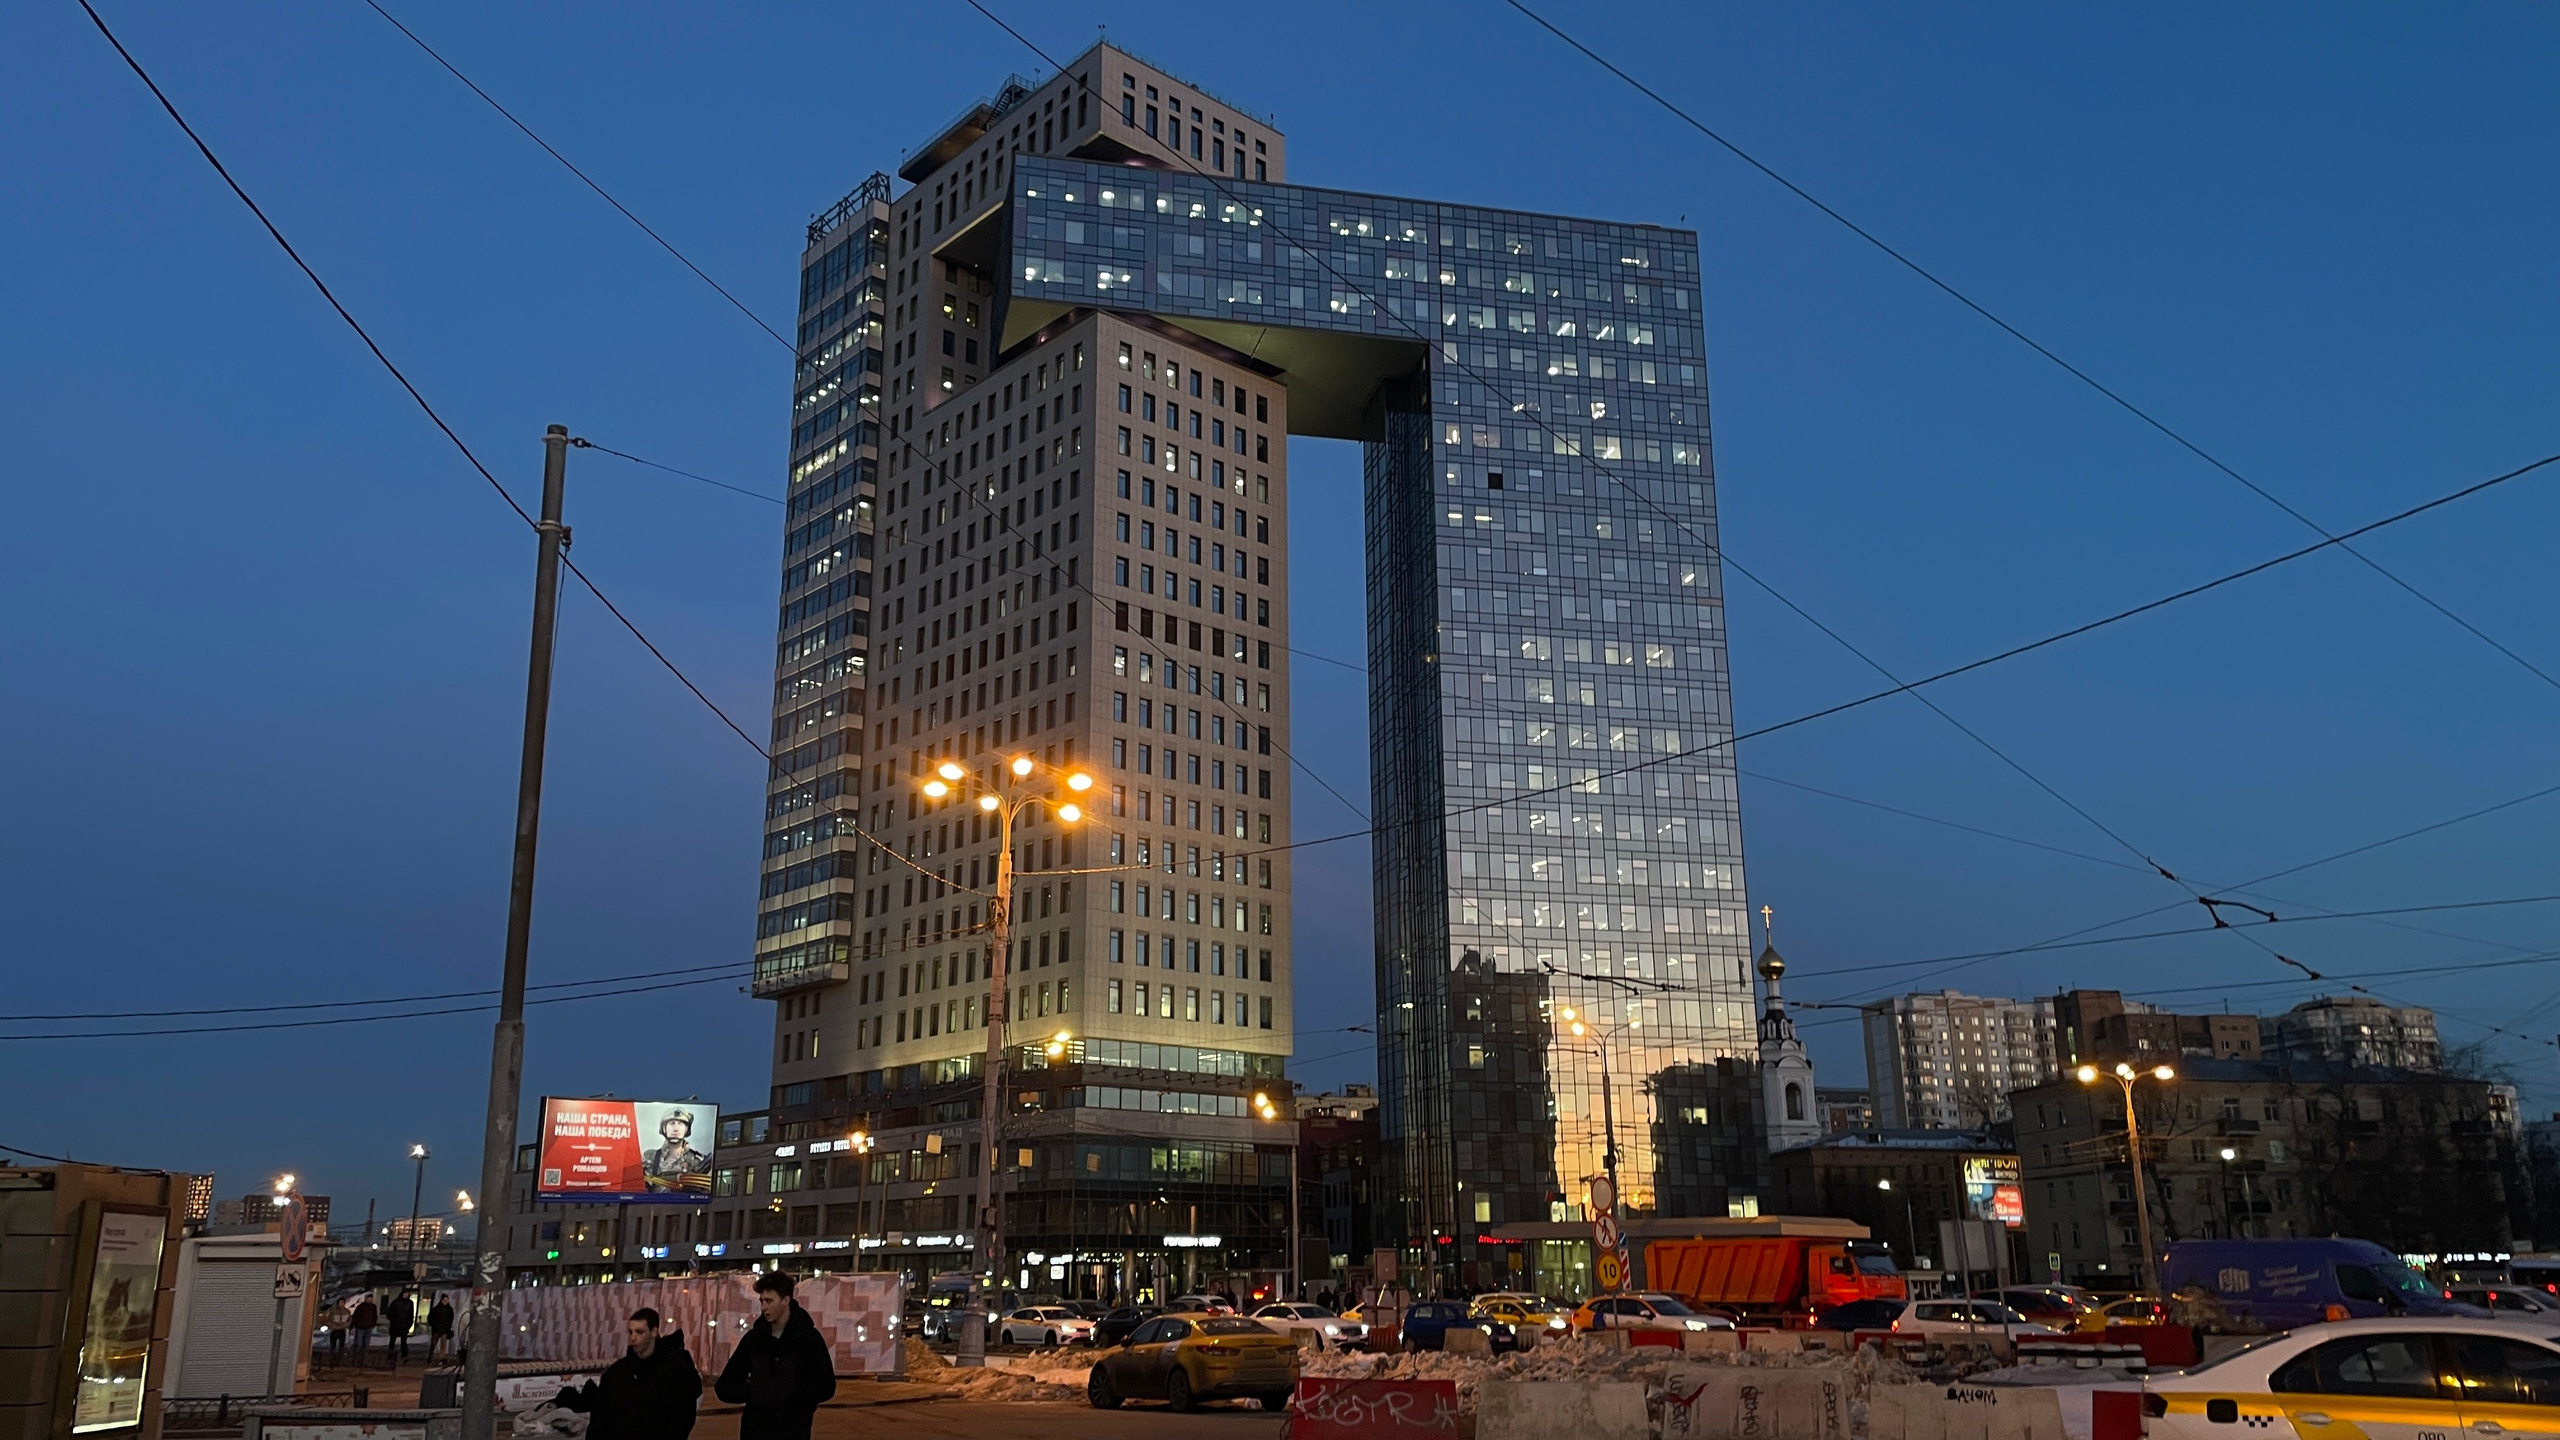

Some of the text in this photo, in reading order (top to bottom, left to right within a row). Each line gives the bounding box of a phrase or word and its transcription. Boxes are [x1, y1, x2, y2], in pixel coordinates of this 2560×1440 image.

[556, 1112, 631, 1126] НАША СТРАНА,
[555, 1125, 631, 1140] НАША ПОБЕДА!
[1603, 1263, 1617, 1279] 10
